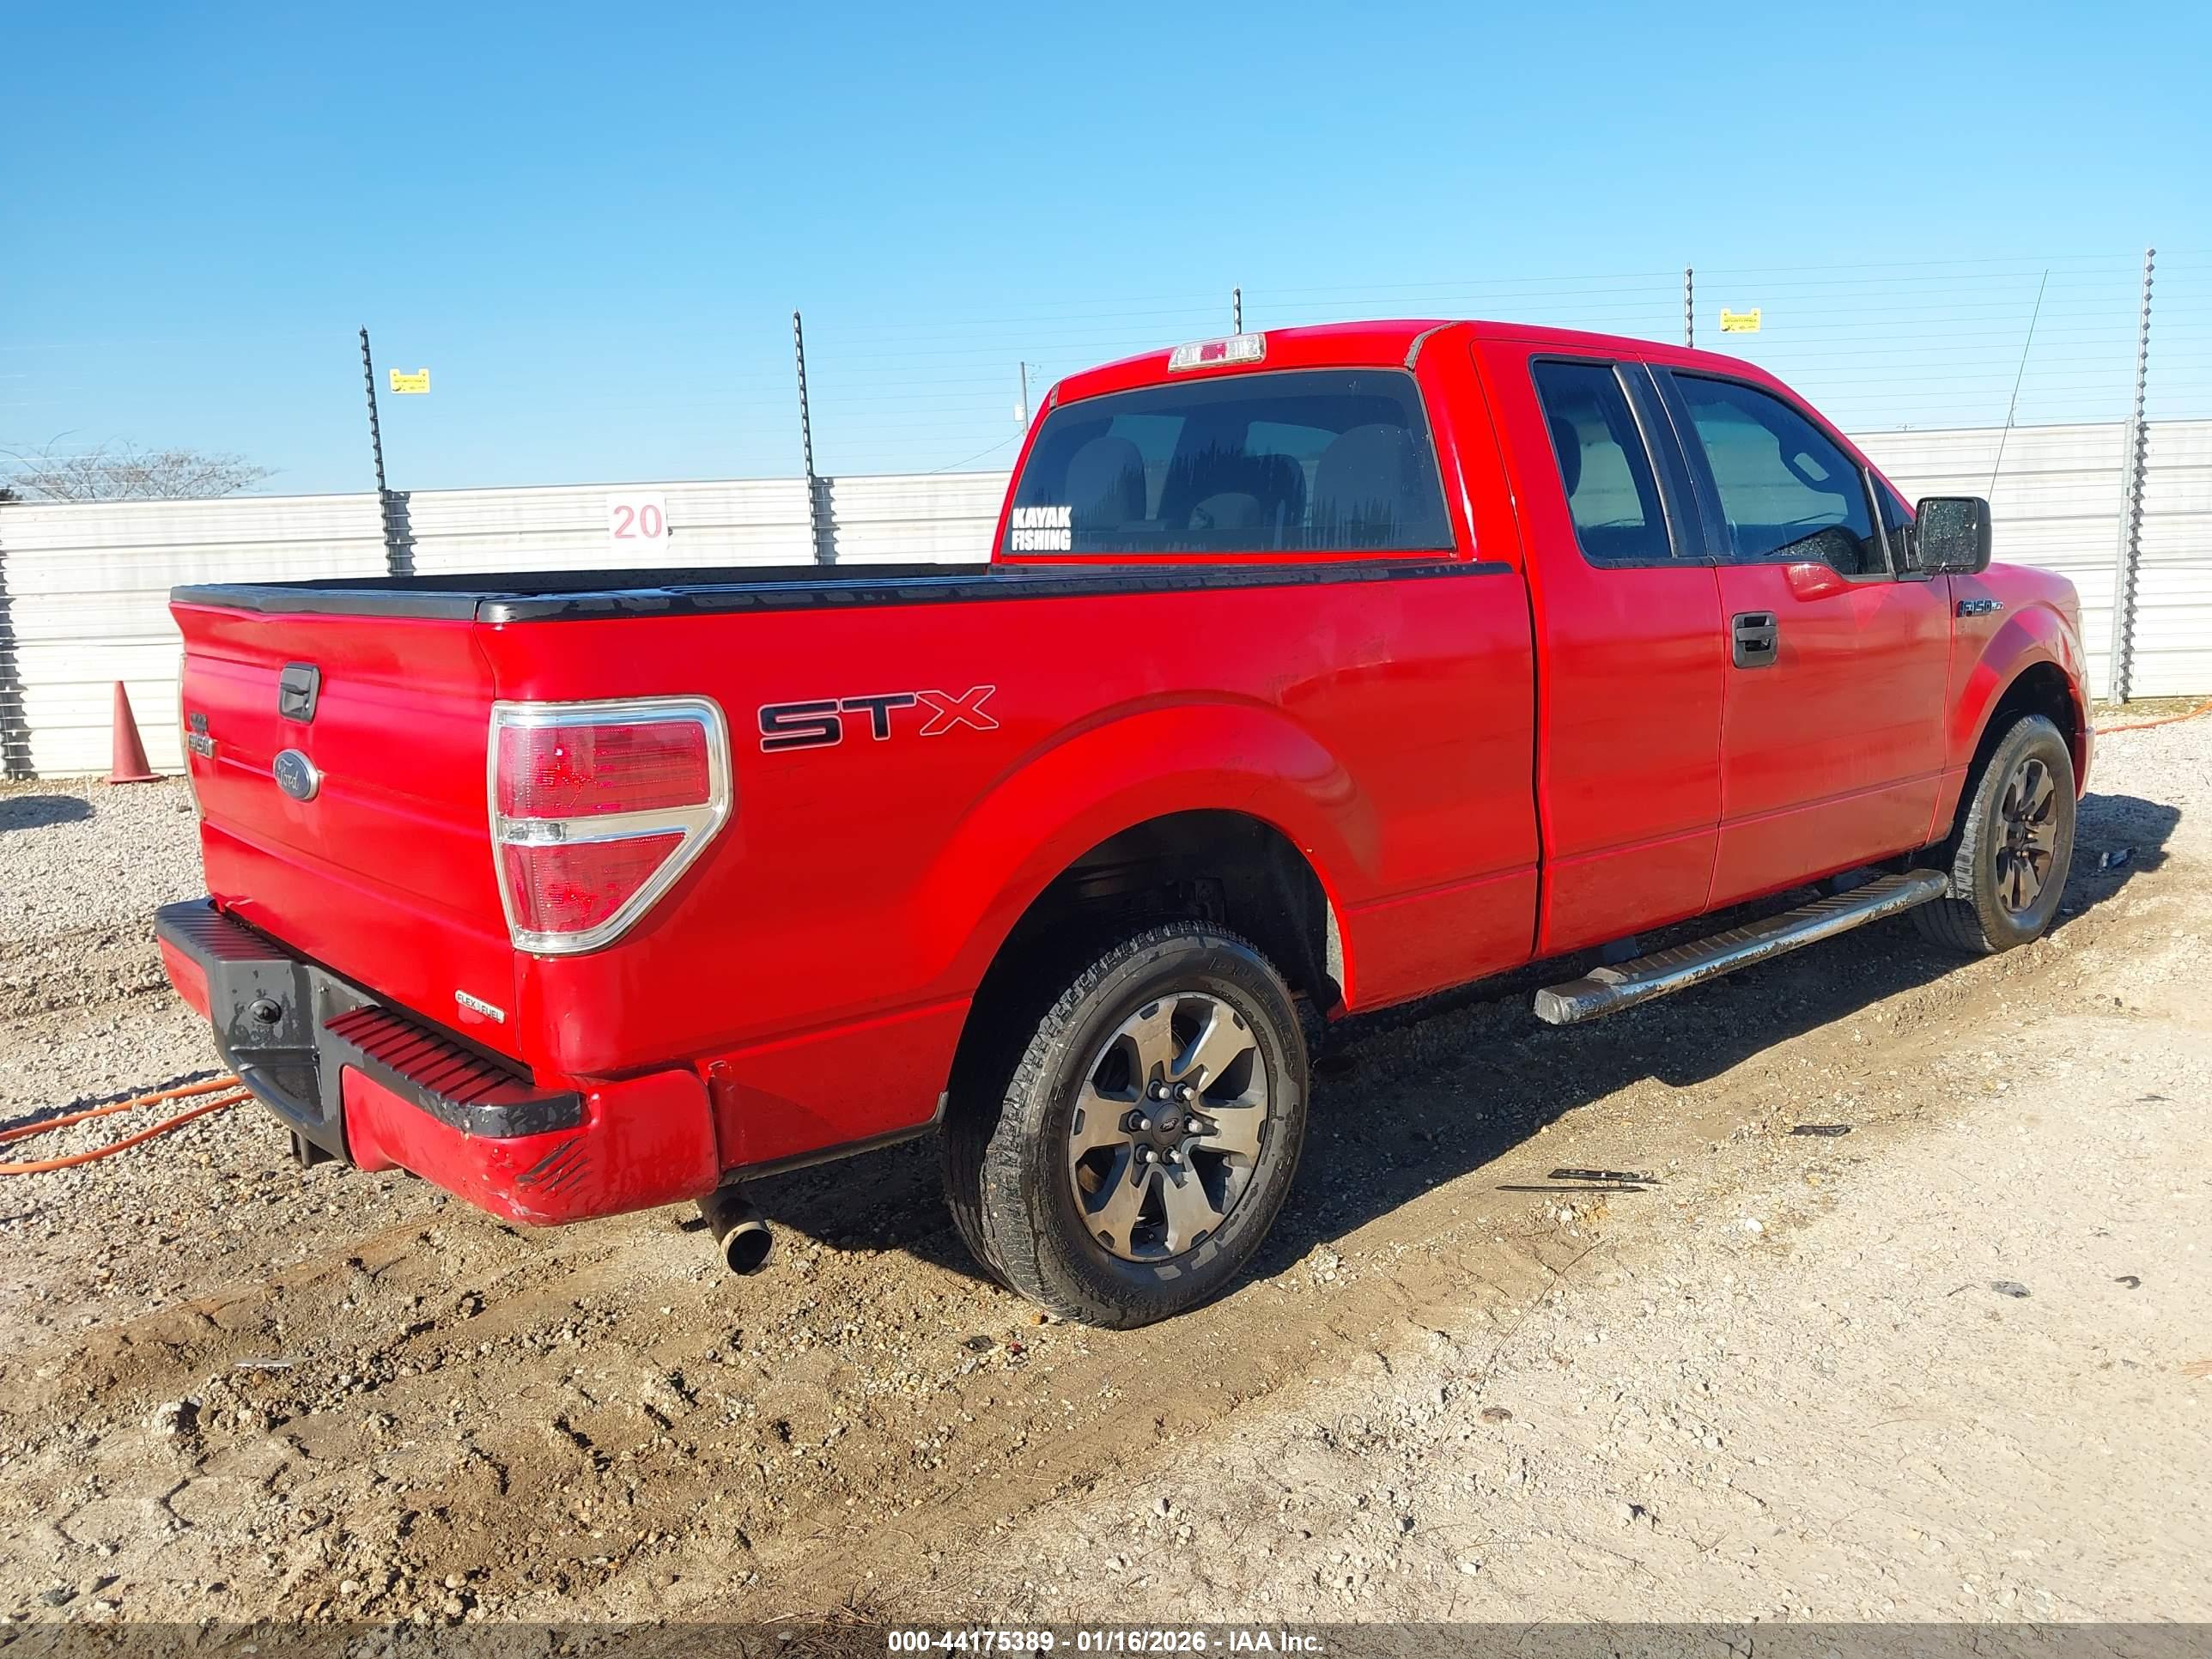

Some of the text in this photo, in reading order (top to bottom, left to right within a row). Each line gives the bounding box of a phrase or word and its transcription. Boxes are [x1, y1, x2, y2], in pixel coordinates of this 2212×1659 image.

[612, 504, 662, 538] 20
[1012, 507, 1073, 529] KAYAK
[1012, 529, 1073, 551] FISHING
[757, 684, 1000, 753] STX
[276, 758, 300, 791] Ford
[457, 993, 501, 1021] FLEX FUEL
